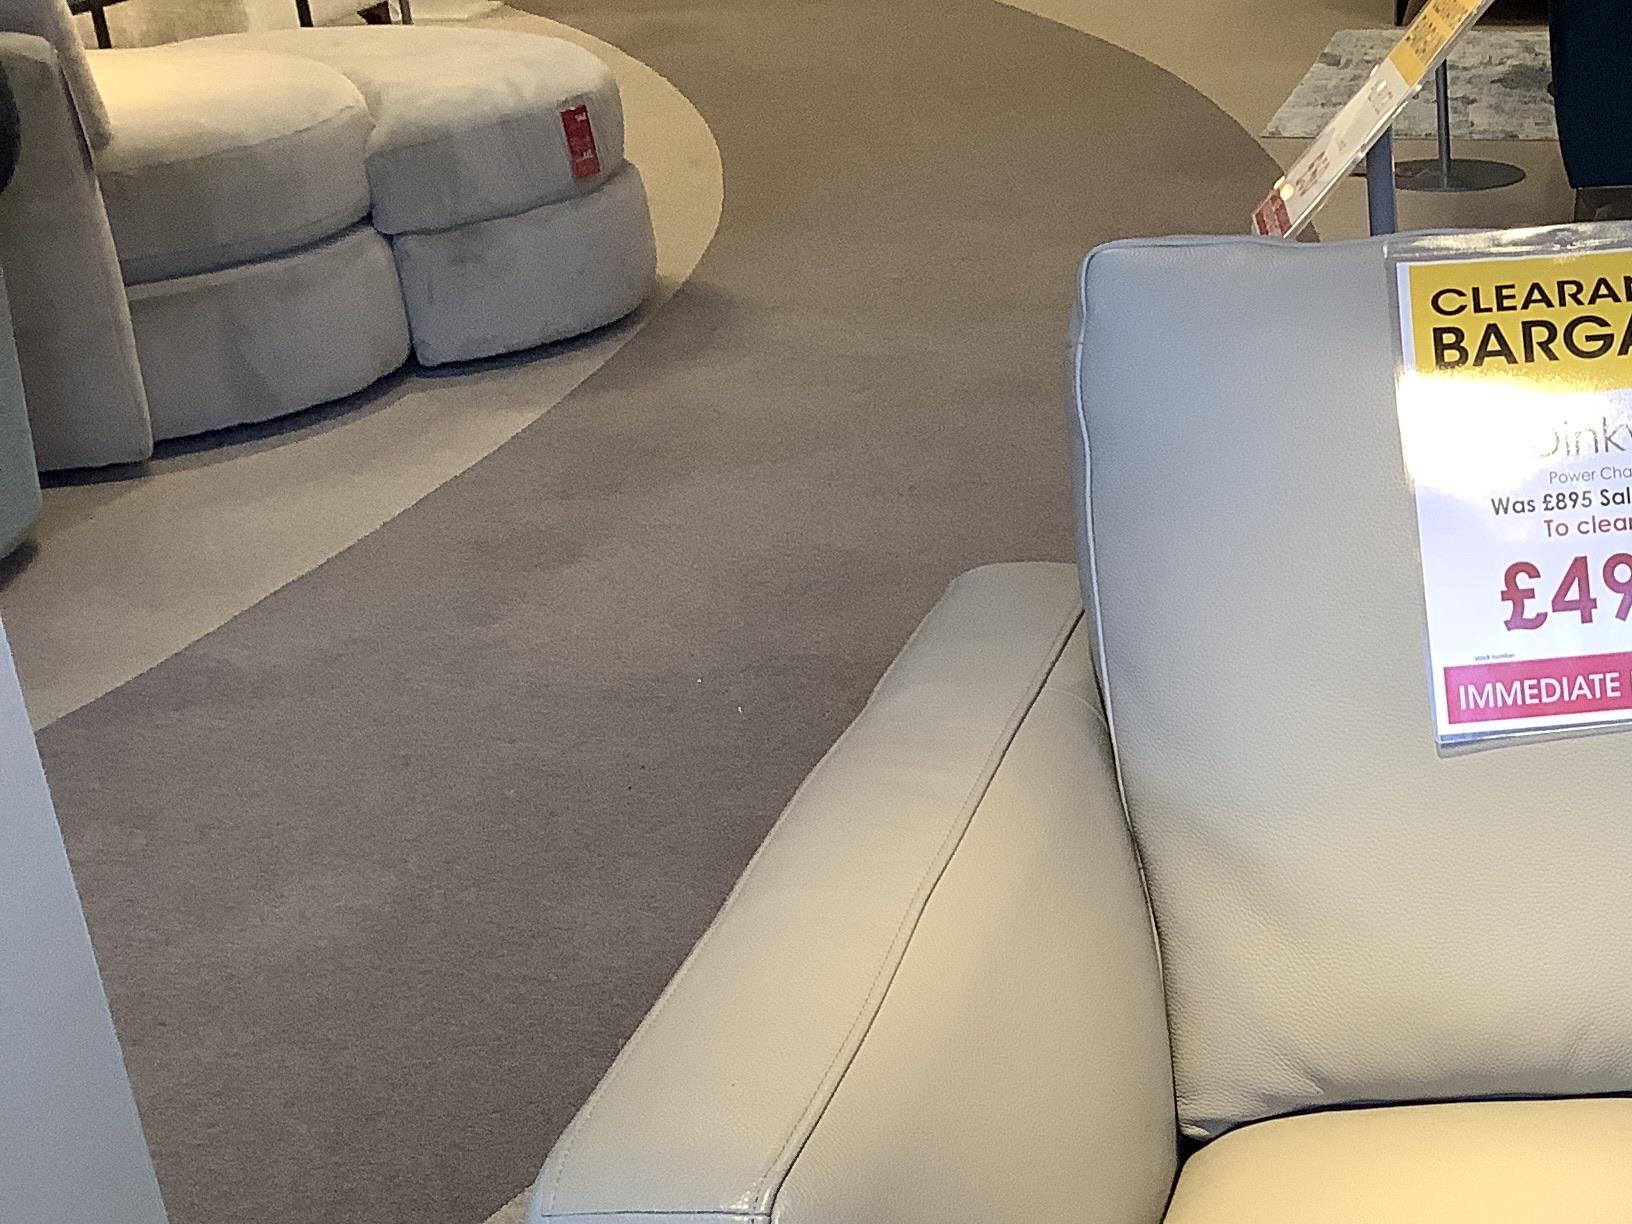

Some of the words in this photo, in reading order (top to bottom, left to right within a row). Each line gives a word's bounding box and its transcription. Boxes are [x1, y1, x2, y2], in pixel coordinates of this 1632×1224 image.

[1549, 469, 1596, 484] Power
[1491, 495, 1537, 516] Was
[1542, 490, 1593, 511] £895
[1544, 518, 1569, 538] To
[1458, 671, 1622, 711] IMMEDIATE
